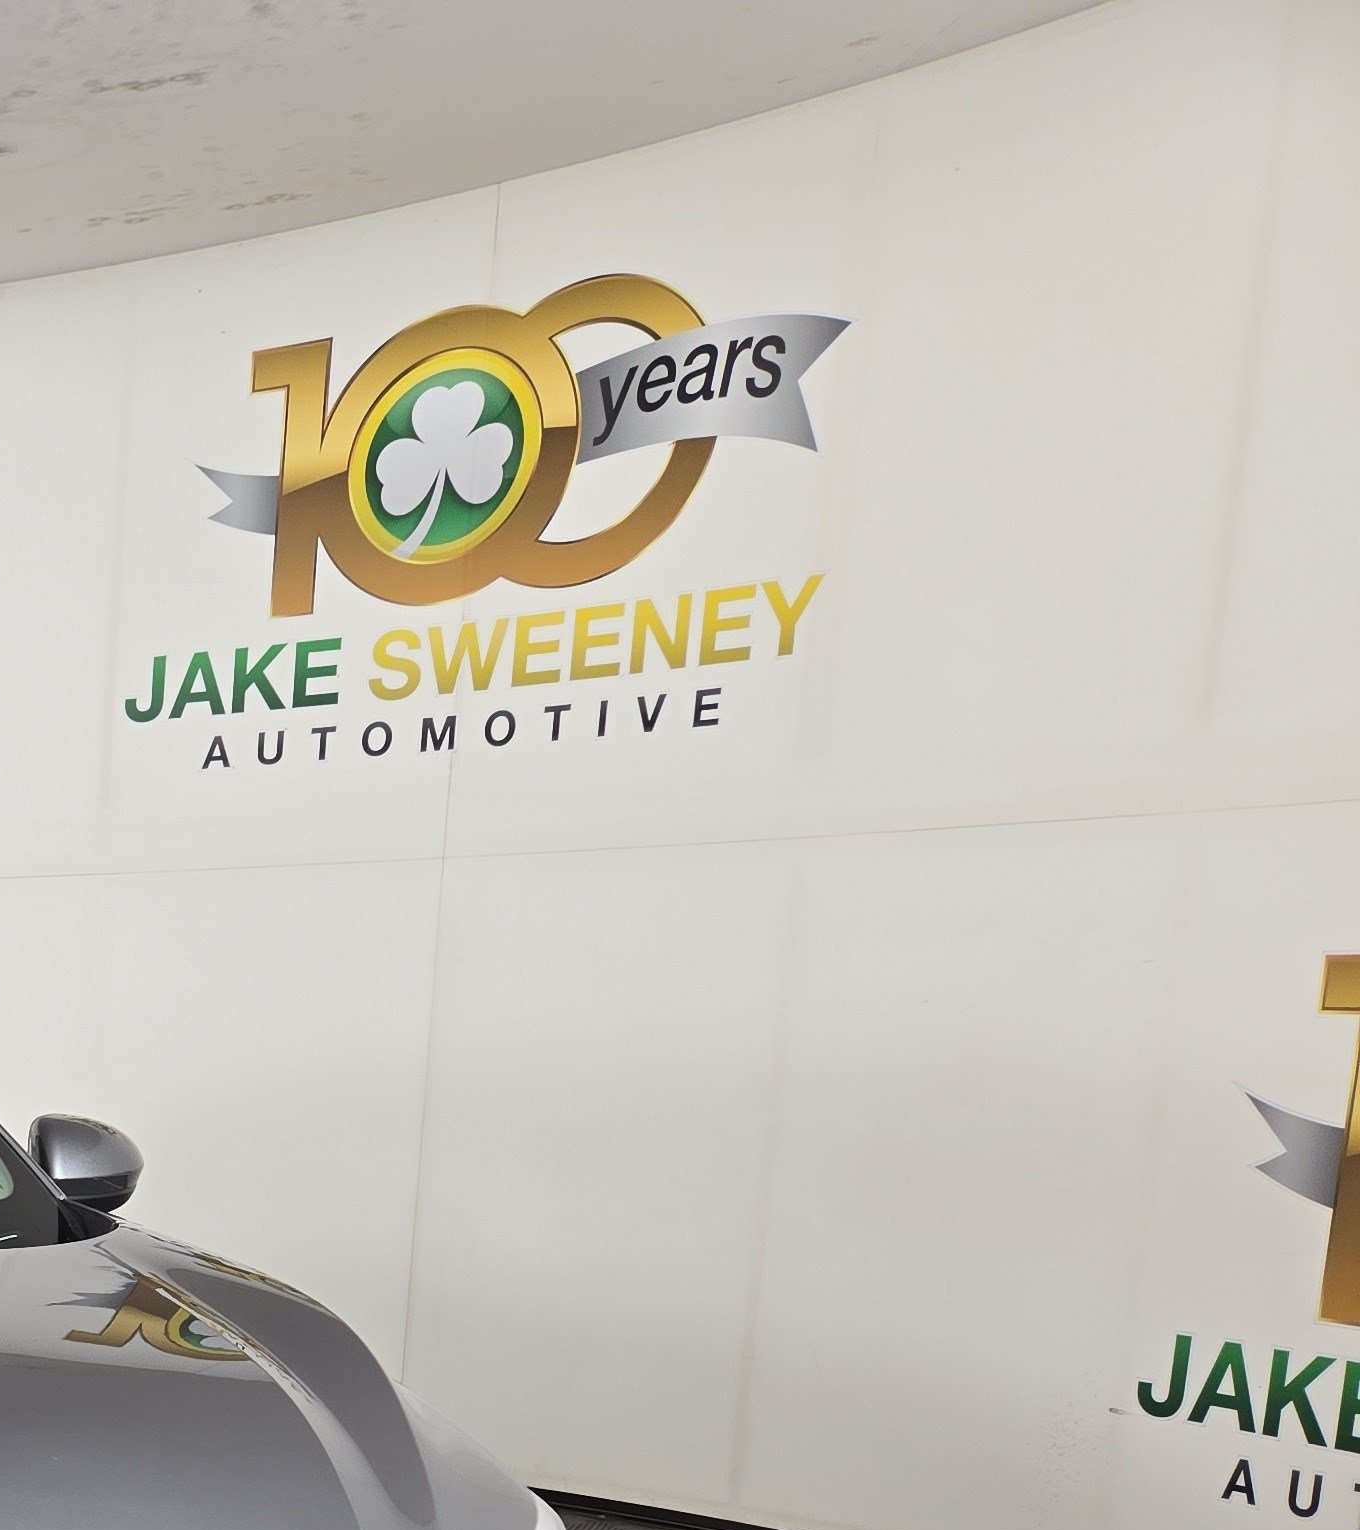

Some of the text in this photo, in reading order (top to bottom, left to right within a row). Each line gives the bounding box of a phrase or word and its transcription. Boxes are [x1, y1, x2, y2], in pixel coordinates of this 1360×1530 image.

[251, 273, 786, 618] 100 years
[124, 574, 826, 723] JAKE SWEENEY
[201, 687, 723, 770] AUTOMOTIVE
